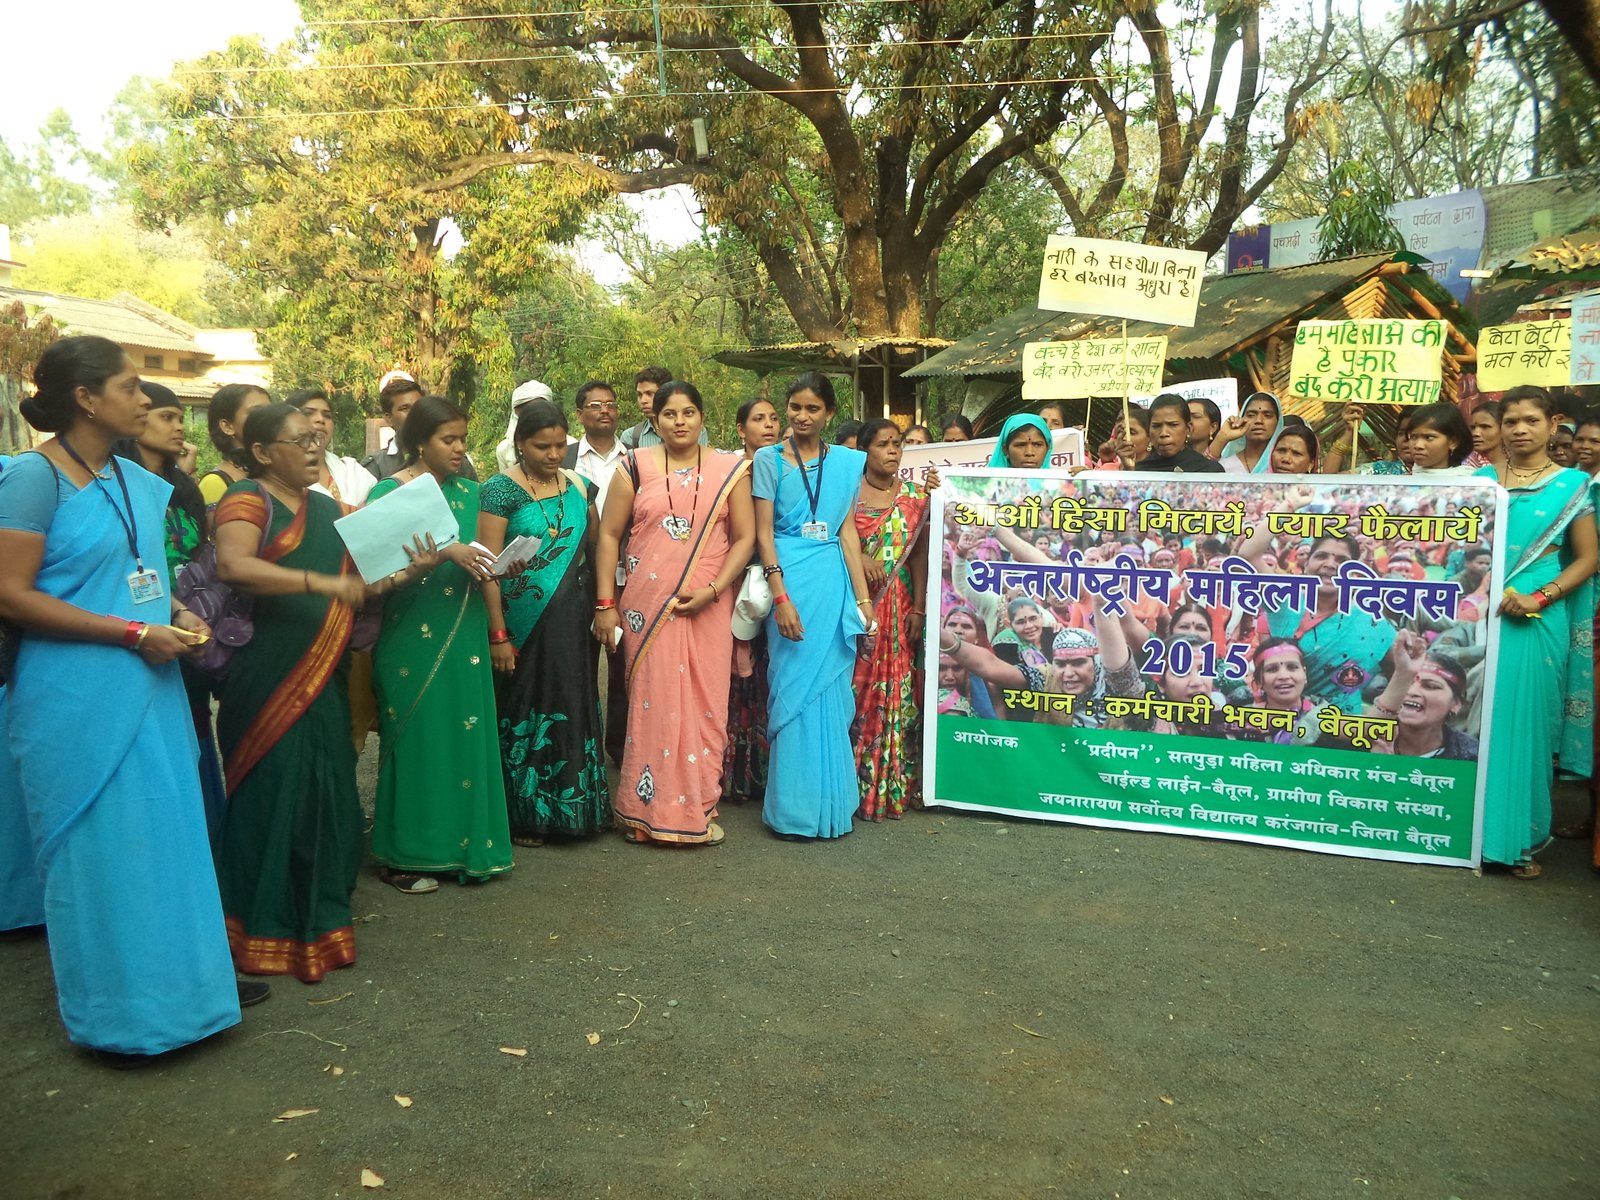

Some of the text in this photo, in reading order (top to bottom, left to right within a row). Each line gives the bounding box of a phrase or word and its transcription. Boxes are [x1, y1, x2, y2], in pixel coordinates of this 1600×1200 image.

[1047, 248, 1197, 279] नारी के सहयोग बिना
[1050, 268, 1069, 282] हर
[1295, 325, 1322, 345] हम
[1411, 321, 1444, 347] की
[1489, 328, 1521, 346] बेटा
[1524, 320, 1564, 345] बेटी
[1086, 341, 1106, 357] देश
[1317, 346, 1398, 376] है पुकार
[1485, 352, 1517, 368] मत
[1520, 345, 1557, 368] करो
[1295, 373, 1322, 398] बंद
[954, 496, 1482, 543] आओं हिंसा मिटायें, प्यार फैलायें
[1182, 556, 1322, 616] महिला
[1332, 560, 1464, 622] दिवस
[1140, 638, 1251, 679] 2015
[1003, 687, 1076, 715] स्थान
[1104, 690, 1214, 725] कर्मचारी
[1222, 702, 1306, 738] भवन,
[1317, 705, 1399, 748] बैतूल
[953, 729, 1019, 749] आयोजक
[1230, 752, 1283, 773] महिला
[1290, 759, 1360, 781] अधिकार
[1098, 770, 1151, 789] चाईल्ड
[1267, 787, 1321, 806] ग्रामीण
[1327, 789, 1388, 812] विकास
[1039, 792, 1122, 812] जयनारायण
[1128, 800, 1183, 819] सर्वोदय
[1189, 803, 1258, 827] विद्यालय
[1405, 826, 1451, 851] बैतूल
